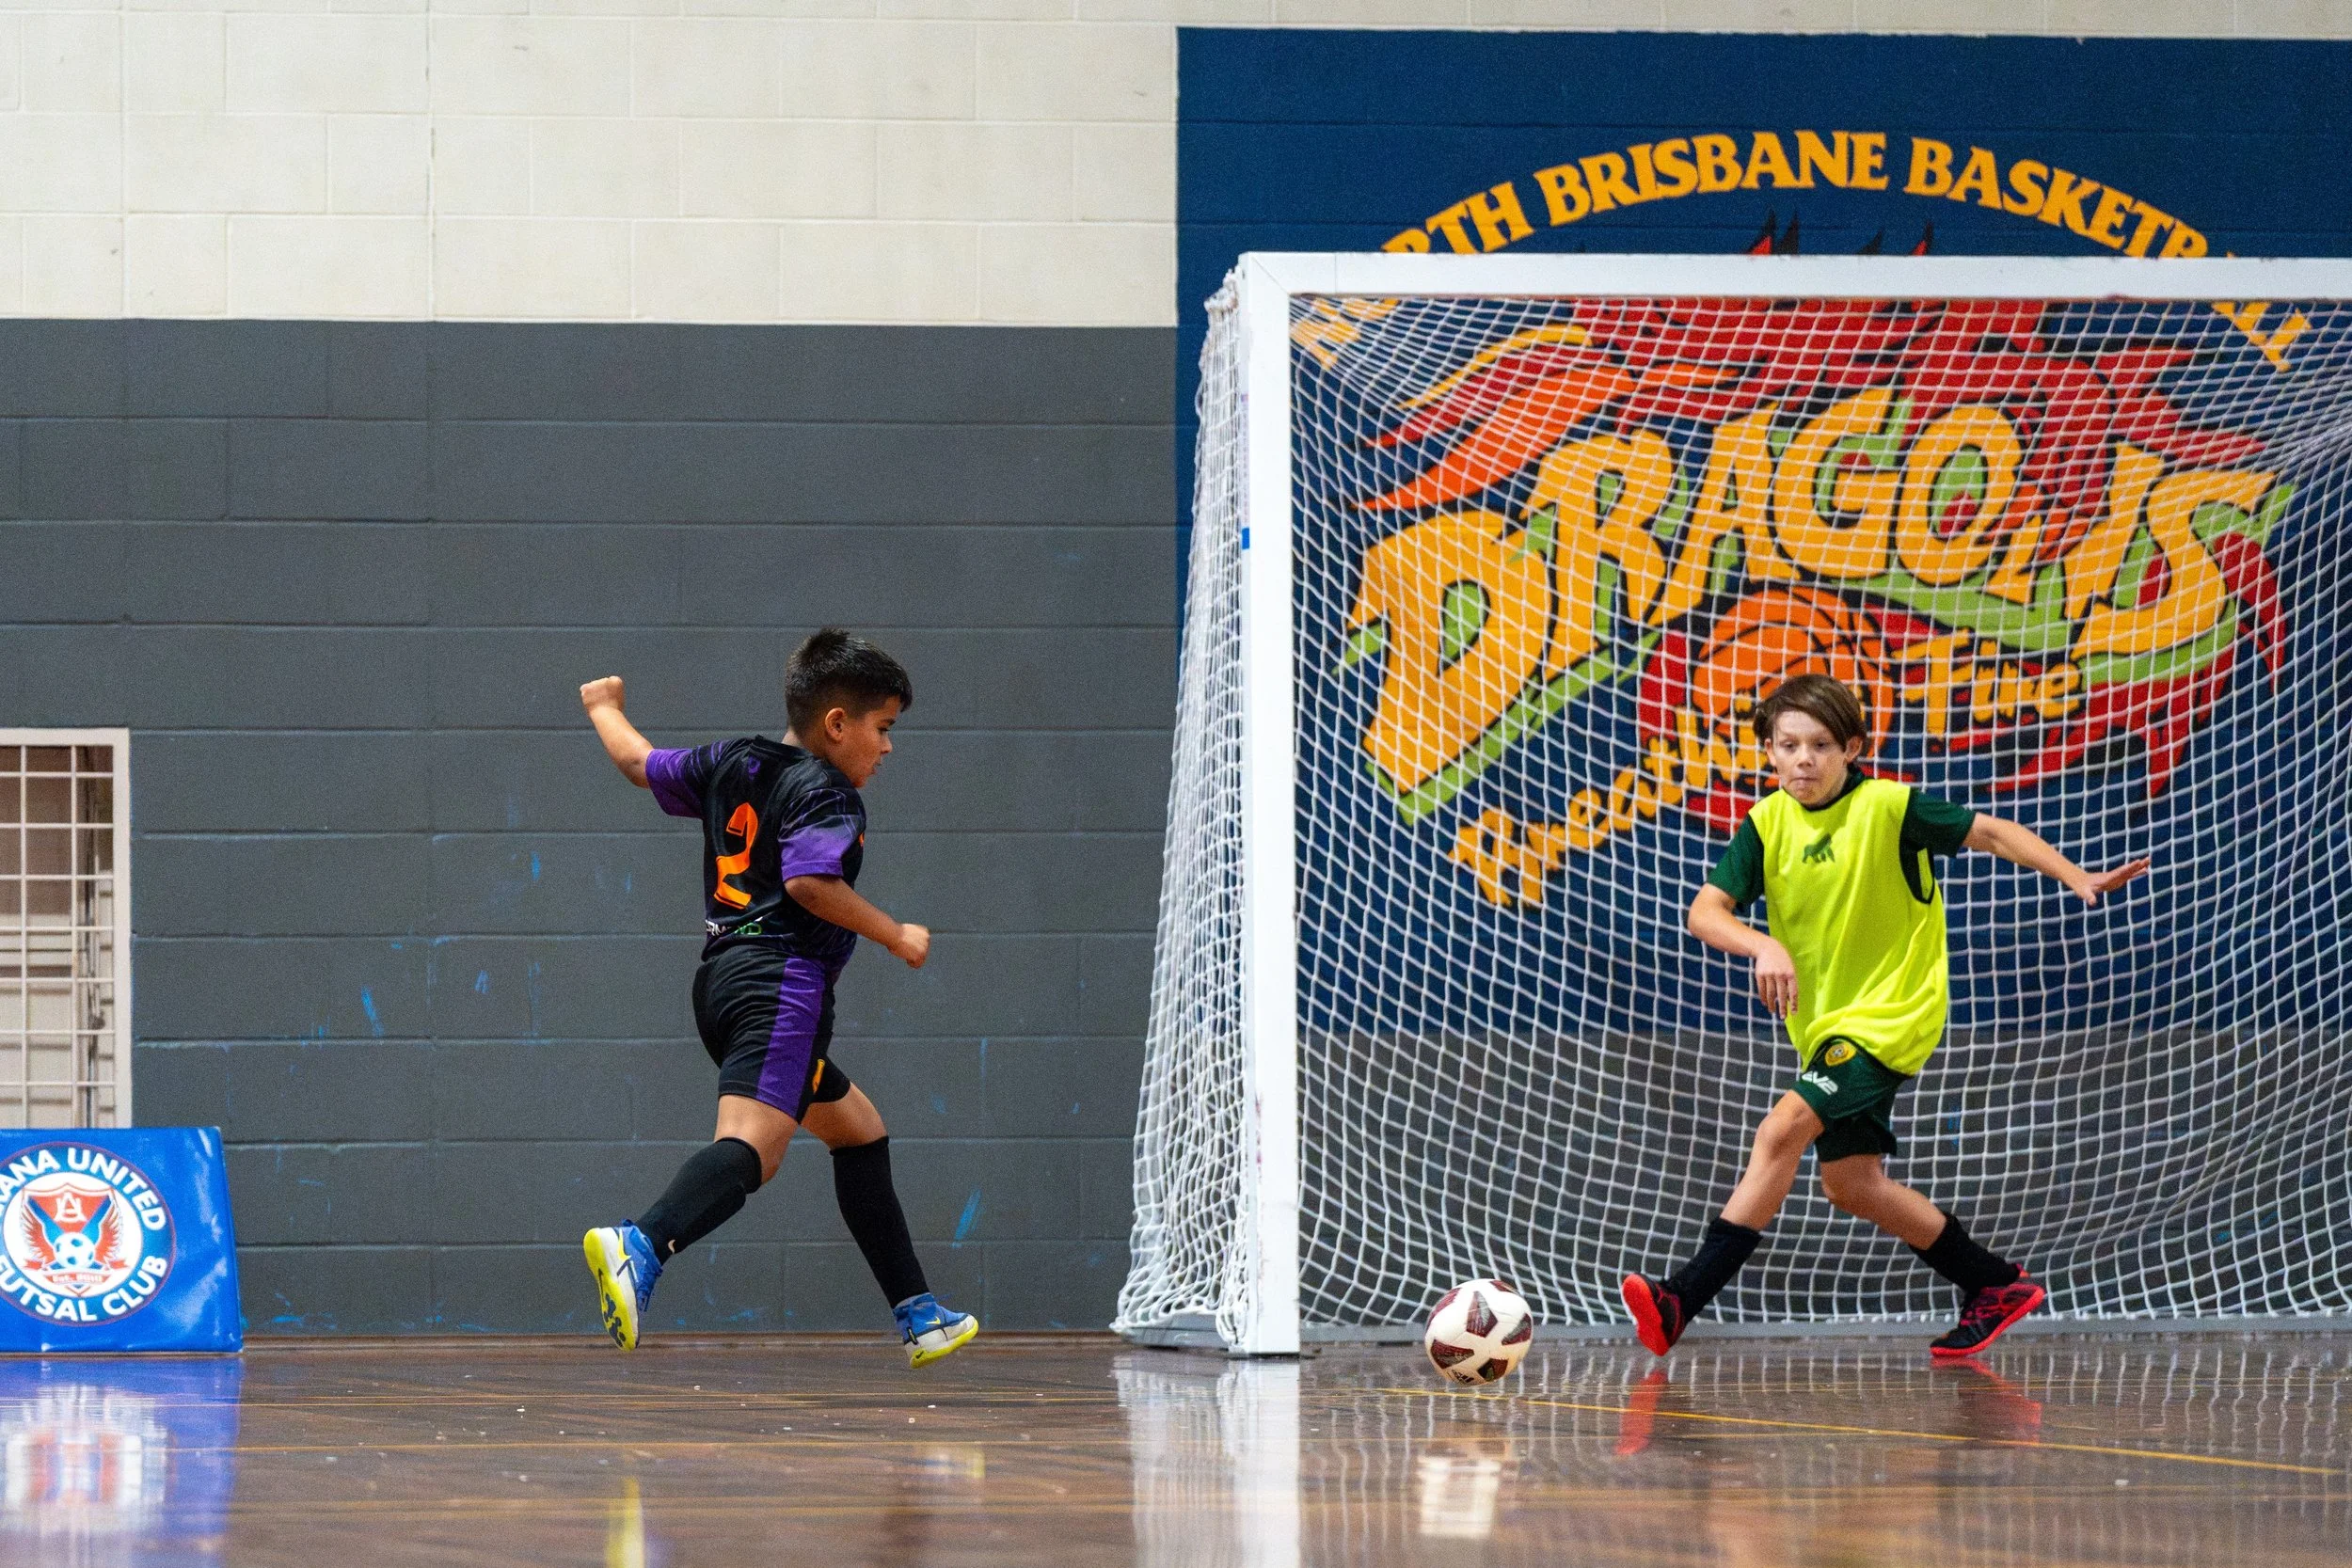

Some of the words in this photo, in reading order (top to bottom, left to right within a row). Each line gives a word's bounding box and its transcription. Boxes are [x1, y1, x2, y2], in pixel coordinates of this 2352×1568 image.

[1533, 130, 1889, 226] BRISBANE
[1347, 388, 2277, 793] DRAGONS
[713, 802, 758, 910] 2
[0, 1148, 60, 1215] ANA
[67, 1147, 167, 1230] UNITED
[102, 1255, 167, 1315] CLUB
